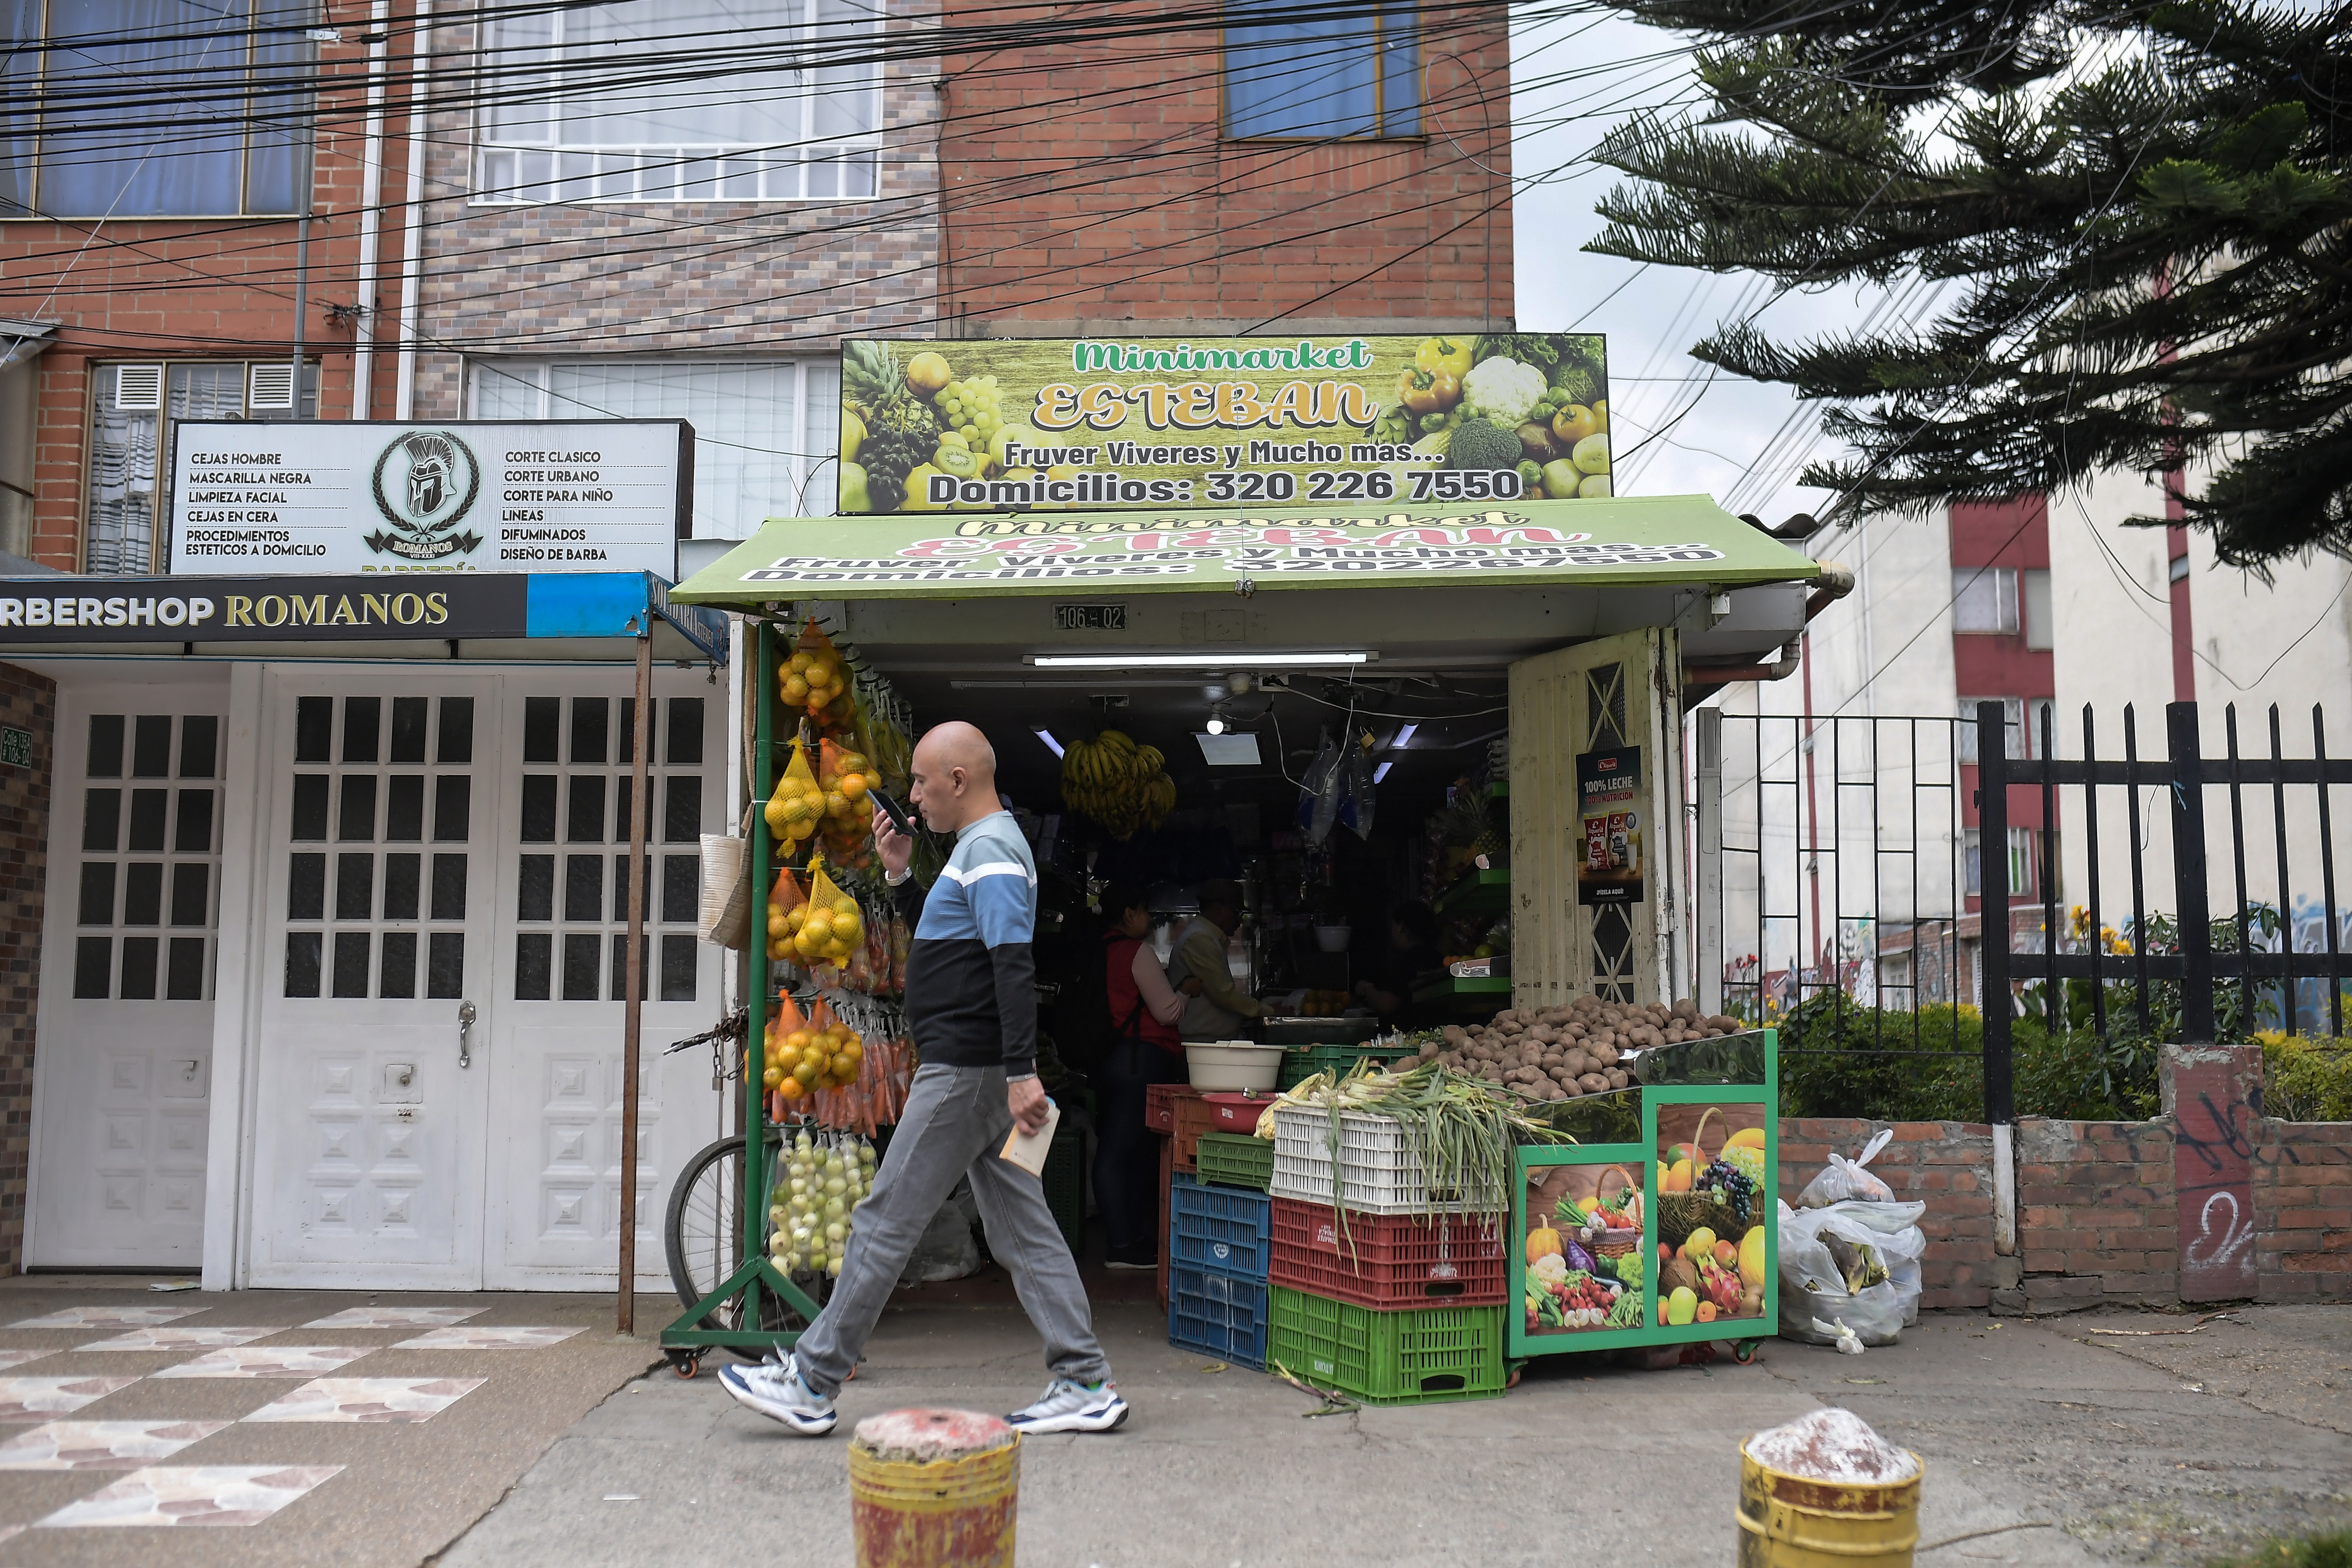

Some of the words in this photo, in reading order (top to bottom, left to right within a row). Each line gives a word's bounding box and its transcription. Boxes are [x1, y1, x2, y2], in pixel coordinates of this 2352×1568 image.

[1075, 340, 1371, 372] Minimarket
[1033, 381, 1377, 430] ESTEBAN
[191, 453, 228, 465] CEJAS
[231, 453, 282, 465] HOMBRE
[505, 451, 546, 463] CORTE
[548, 451, 601, 463] CLASICO
[1005, 442, 1099, 466] Fruver
[1107, 442, 1217, 464] Viveres
[1225, 448, 1240, 469] y
[1250, 441, 1342, 463] Mucho
[1351, 445, 1443, 462] mas...
[189, 472, 266, 484] MASCARILLA
[269, 472, 312, 484] NEGRA
[504, 471, 545, 482] CORTE
[548, 470, 600, 482] URBANO
[503, 490, 543, 502] CORTE
[546, 490, 578, 502] PARA
[582, 487, 613, 502] NIÑO
[930, 474, 1191, 504] Domicilios:
[1208, 472, 1293, 500] 320
[1309, 472, 1394, 500] 226
[1408, 471, 1519, 499] 7550
[188, 492, 242, 503] LIMPIEZA
[246, 492, 288, 503] FACIAL
[187, 511, 224, 522] CEJAS
[227, 511, 243, 523] EN
[246, 511, 278, 523] CERA
[502, 510, 544, 521] LINEAS
[956, 511, 1530, 536] Minimarket
[186, 530, 290, 542] PROCEDIMIENTOS
[501, 529, 586, 541] DIFUMINADOS
[899, 527, 1587, 557] ESTEBAN
[185, 544, 248, 555] ESTETICOS
[250, 544, 259, 556] A
[263, 544, 326, 556] DOMICILIO
[393, 541, 453, 554] ROMANOS
[500, 545, 544, 560] DISEÑO
[547, 549, 564, 560] DE
[566, 549, 608, 561] BARBA
[776, 557, 973, 568] Fruver
[1004, 549, 1224, 566] Viveres
[1242, 548, 1276, 559] y
[1298, 547, 1488, 559] Mucho
[1507, 543, 1701, 556] mas...
[747, 565, 1189, 580] Domicilios:
[0, 597, 215, 627] RBERSHOP
[224, 592, 448, 627] ROMANOS
[1059, 607, 1086, 628] 106
[1103, 607, 1121, 628] 02
[697, 621, 714, 648] STEREO
[1584, 779, 1606, 793] 100%
[1607, 776, 1633, 790] LECHE
[1586, 795, 1601, 805] 100%
[1602, 790, 1633, 803] NUTRICIÓN
